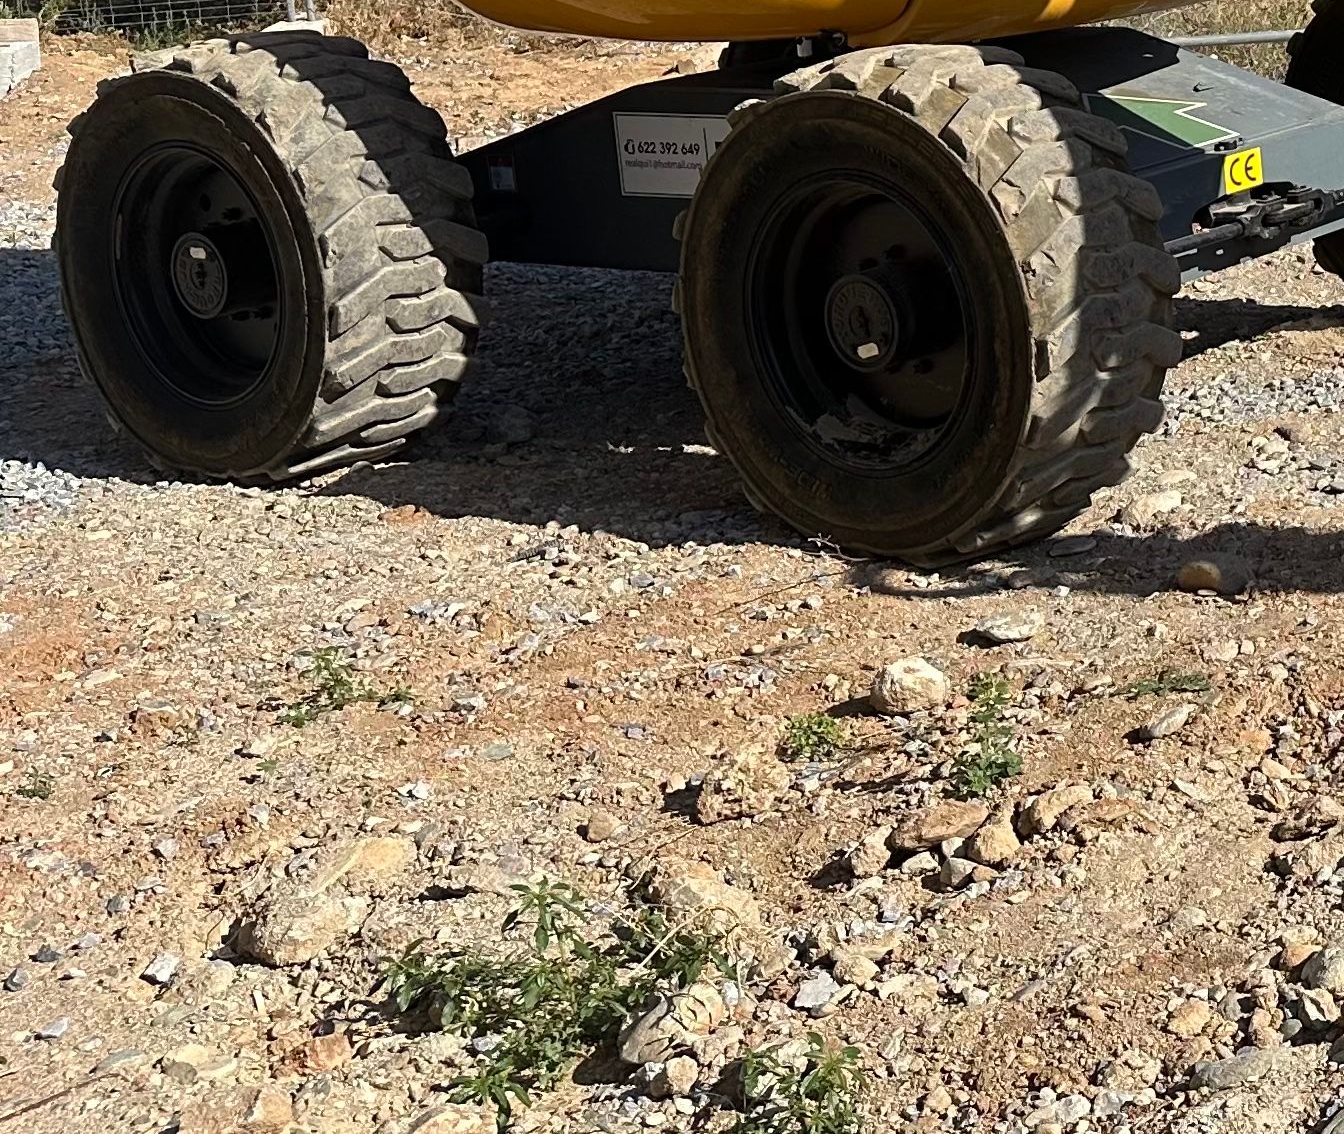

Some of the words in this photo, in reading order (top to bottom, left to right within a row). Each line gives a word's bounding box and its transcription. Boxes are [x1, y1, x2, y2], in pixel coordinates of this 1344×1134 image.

[638, 141, 657, 154] 622
[659, 142, 679, 155] 392
[681, 143, 700, 155] 649
[1229, 153, 1257, 187] CE
